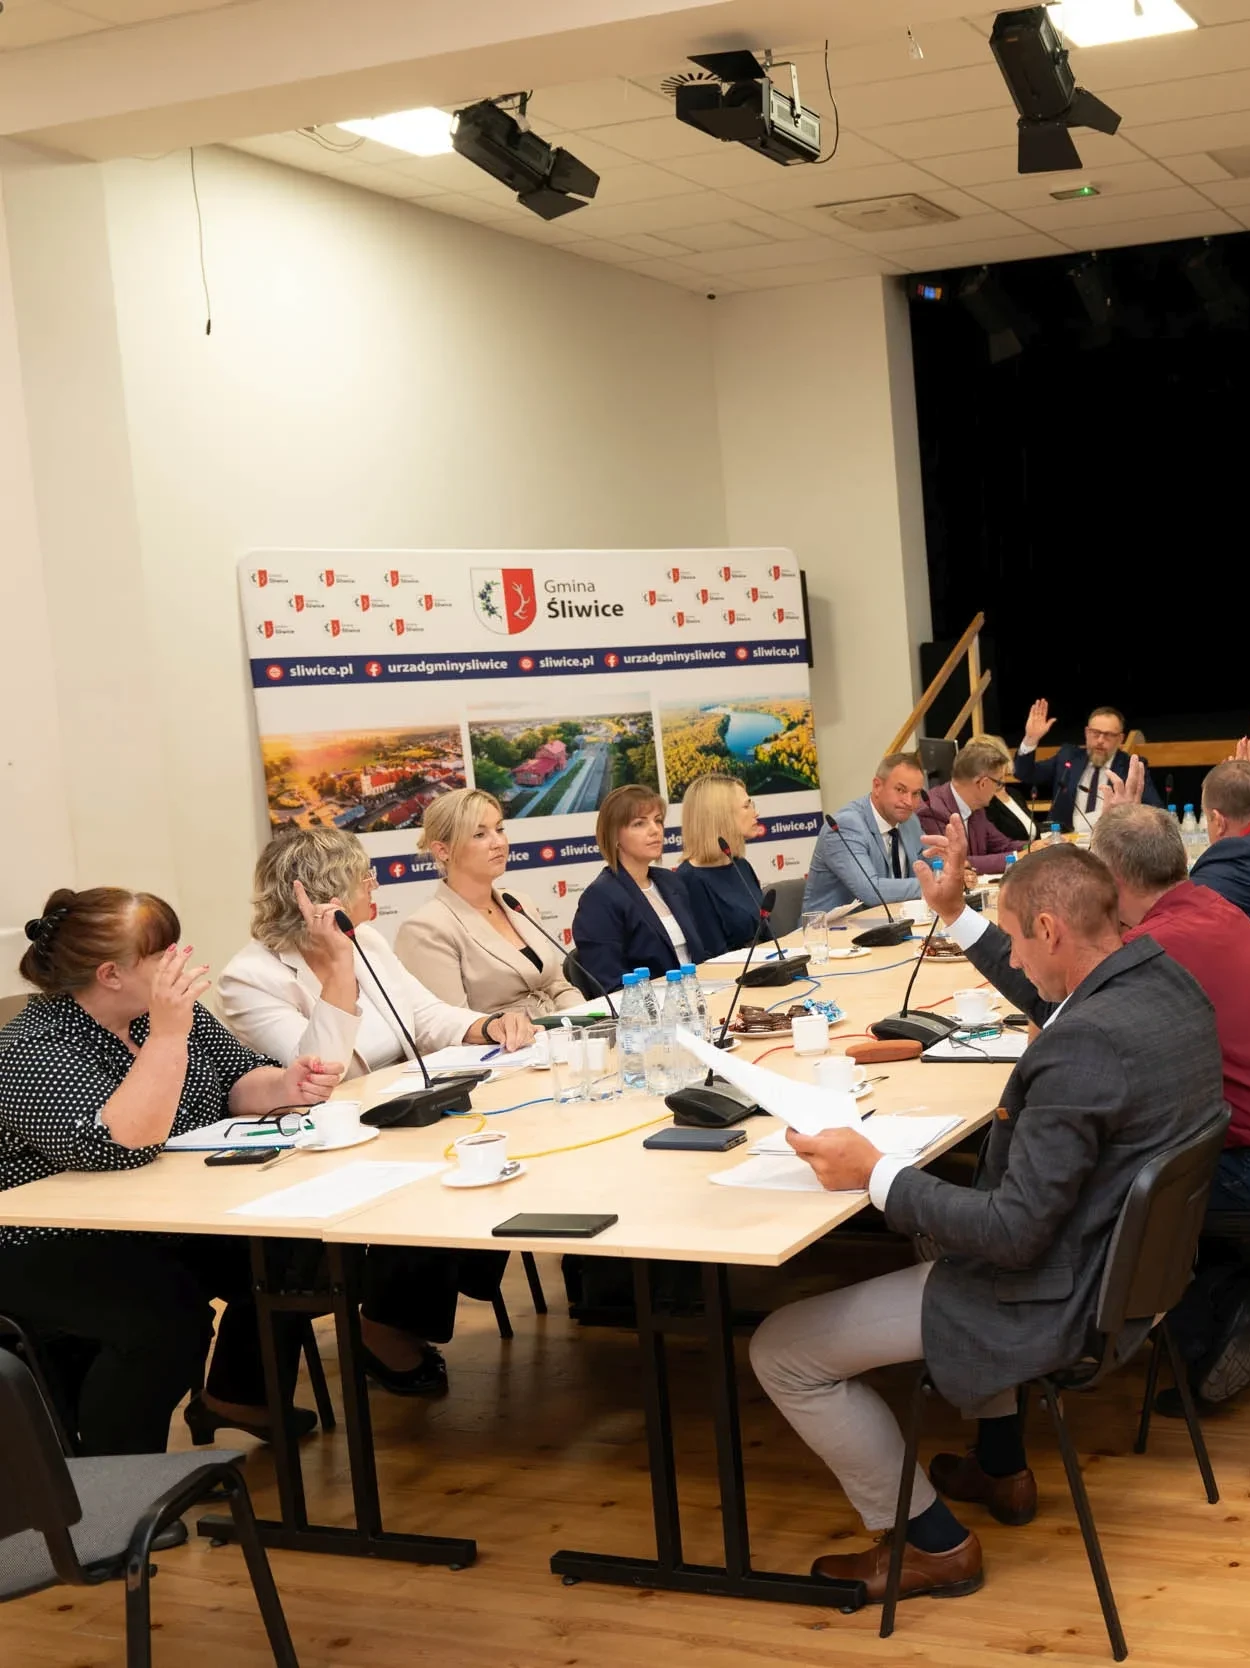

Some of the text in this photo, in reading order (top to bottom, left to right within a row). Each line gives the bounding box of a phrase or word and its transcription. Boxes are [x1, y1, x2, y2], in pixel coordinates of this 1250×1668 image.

[544, 578, 596, 594] Gmina
[546, 597, 625, 619] Śliwice
[289, 644, 801, 678] sliwice.pl urzadgminysliwice sliwice.pl urzadgminysliwice sliwice.pl
[560, 818, 818, 857] sliwice sliwice.pl
